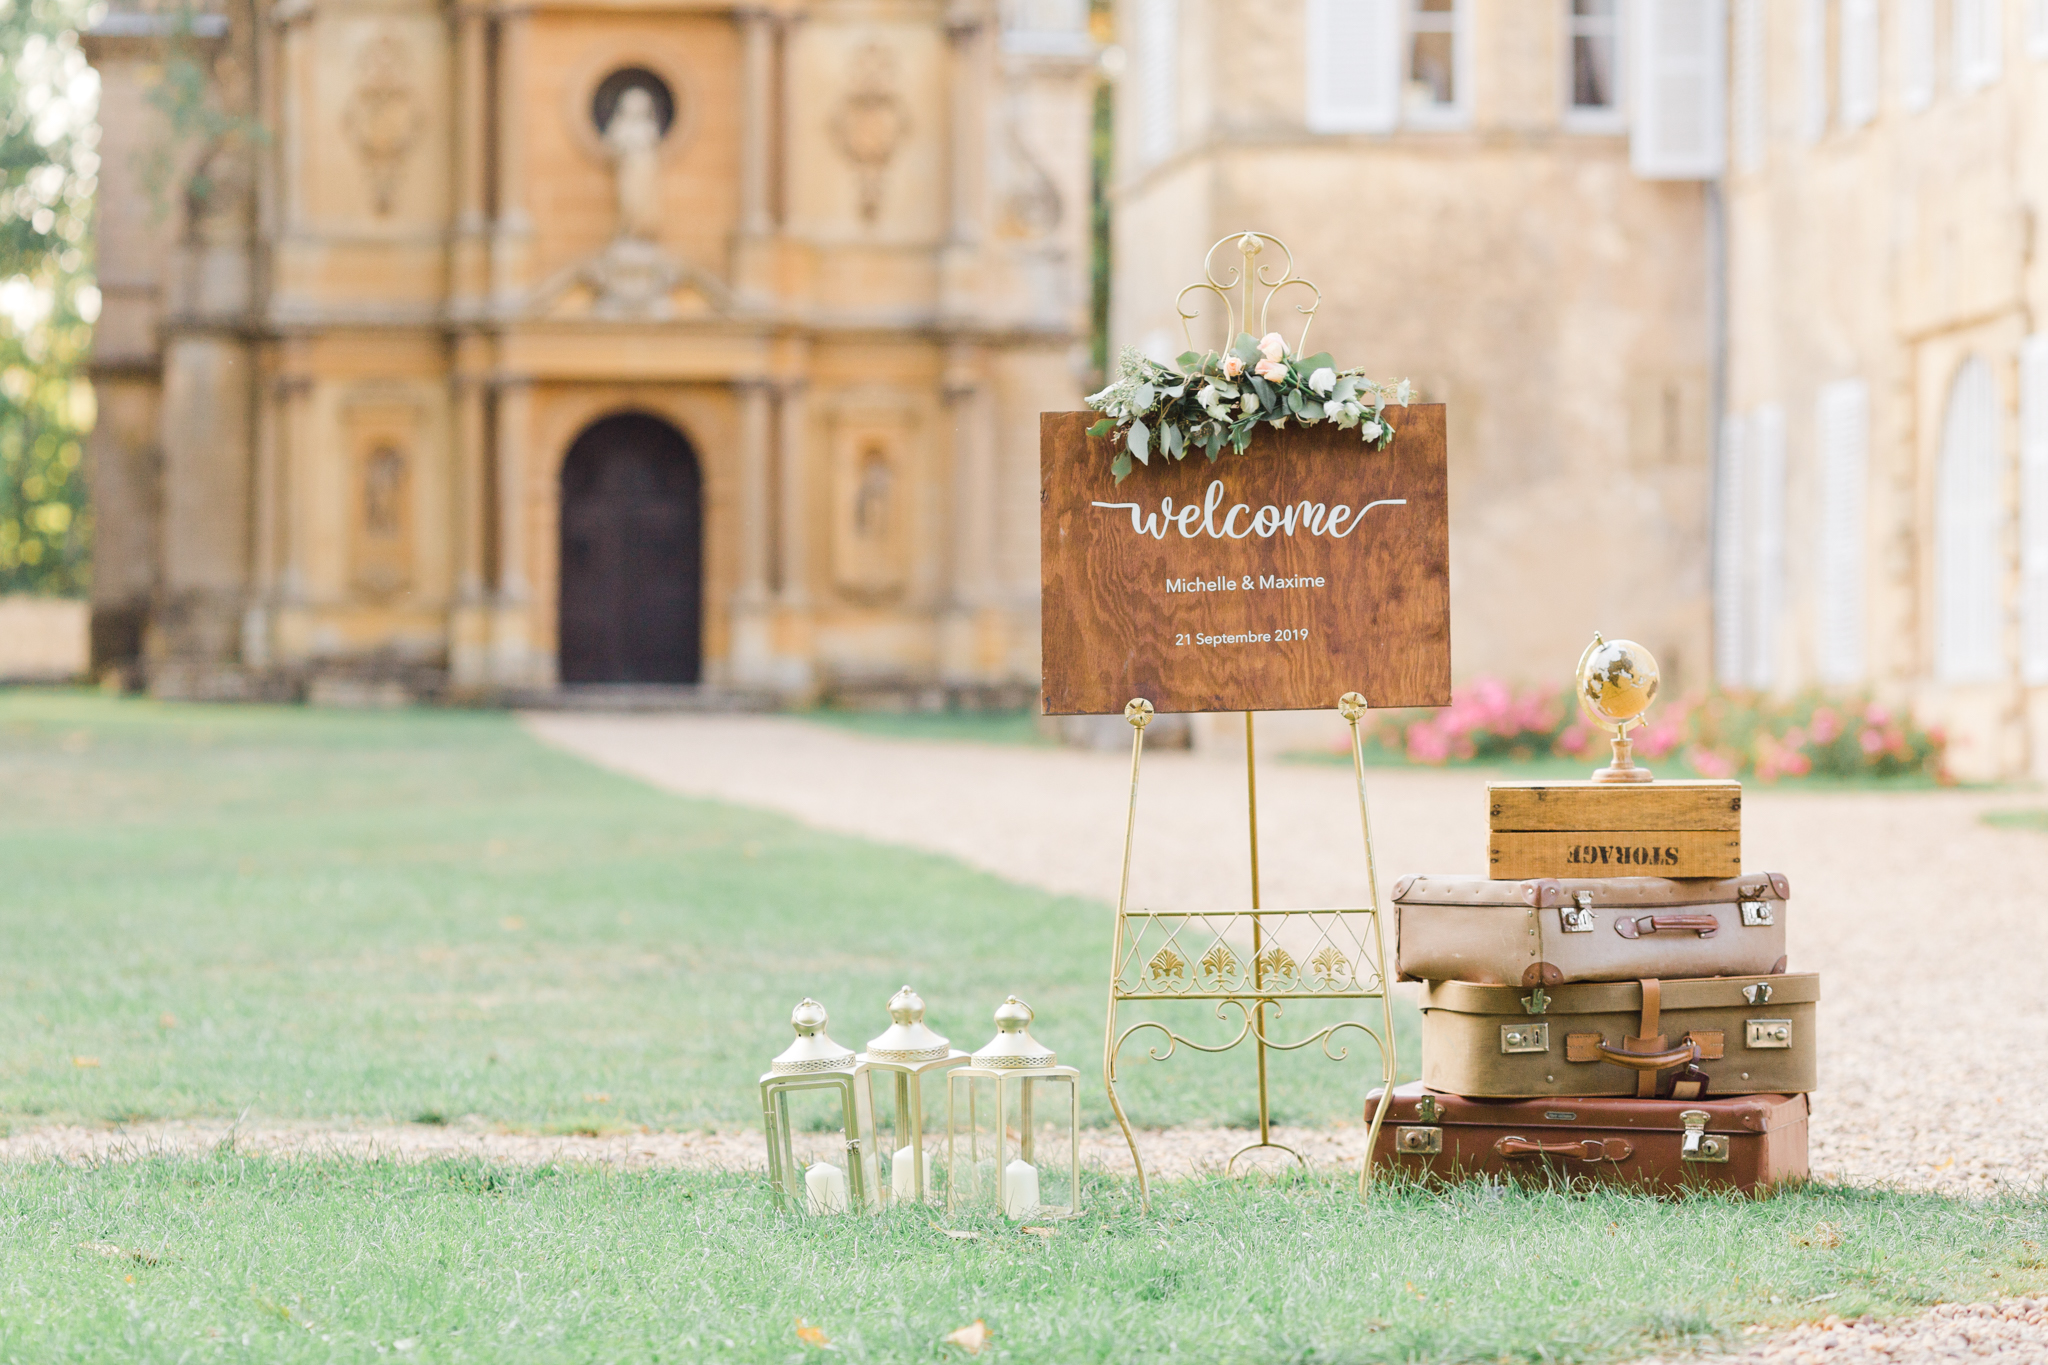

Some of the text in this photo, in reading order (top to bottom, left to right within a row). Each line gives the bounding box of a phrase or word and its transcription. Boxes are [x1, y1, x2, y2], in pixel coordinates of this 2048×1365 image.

[1091, 479, 1407, 540] welcome
[1165, 573, 1326, 593] Michelle & Maxime
[1175, 628, 1309, 648] 21 Septembre 2019
[1566, 845, 1679, 866] STORAGE
